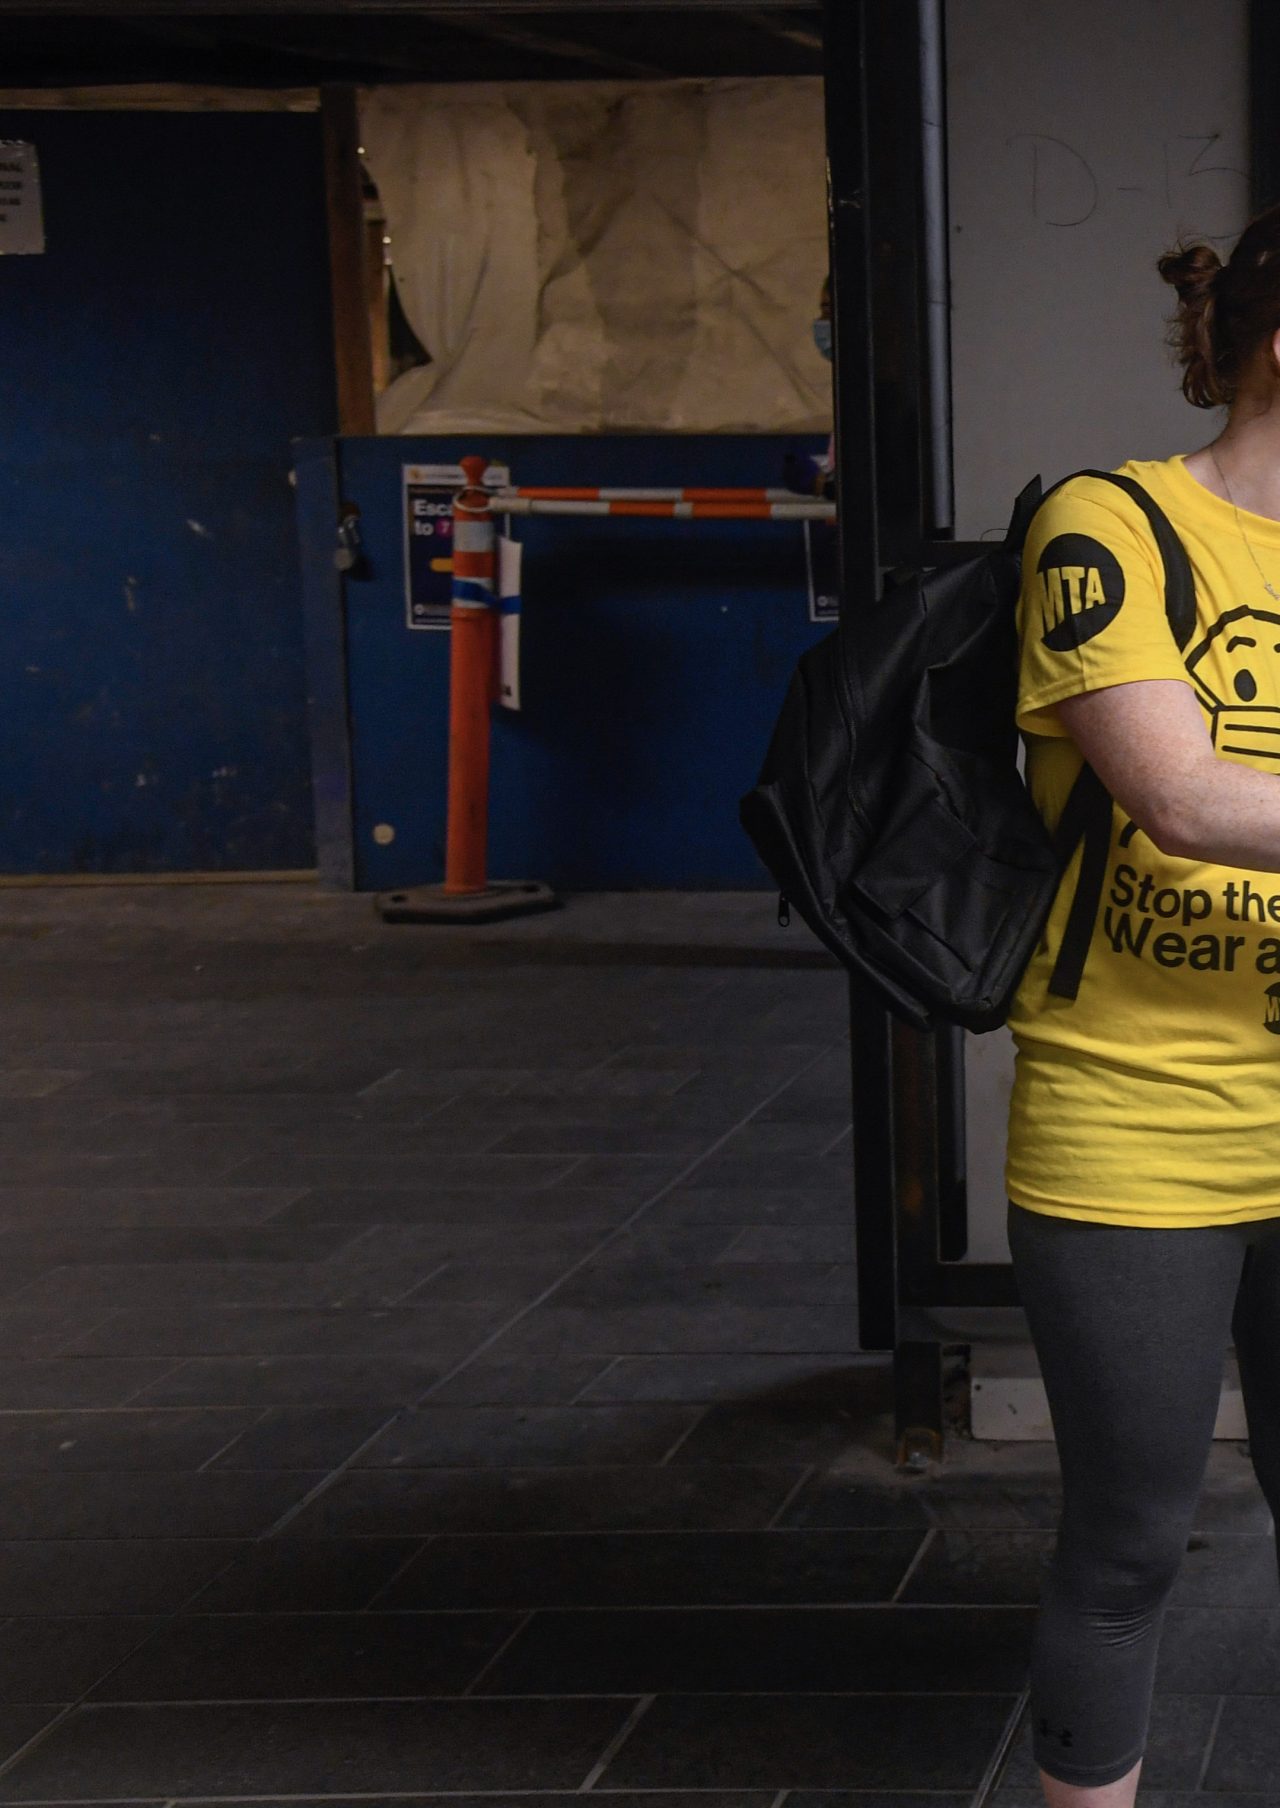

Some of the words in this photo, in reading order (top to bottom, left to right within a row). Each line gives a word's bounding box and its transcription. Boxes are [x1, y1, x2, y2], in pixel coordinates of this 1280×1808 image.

[1036, 565, 1107, 640] MTA
[1109, 863, 1213, 926] Stop
[1103, 906, 1245, 973] Wear
